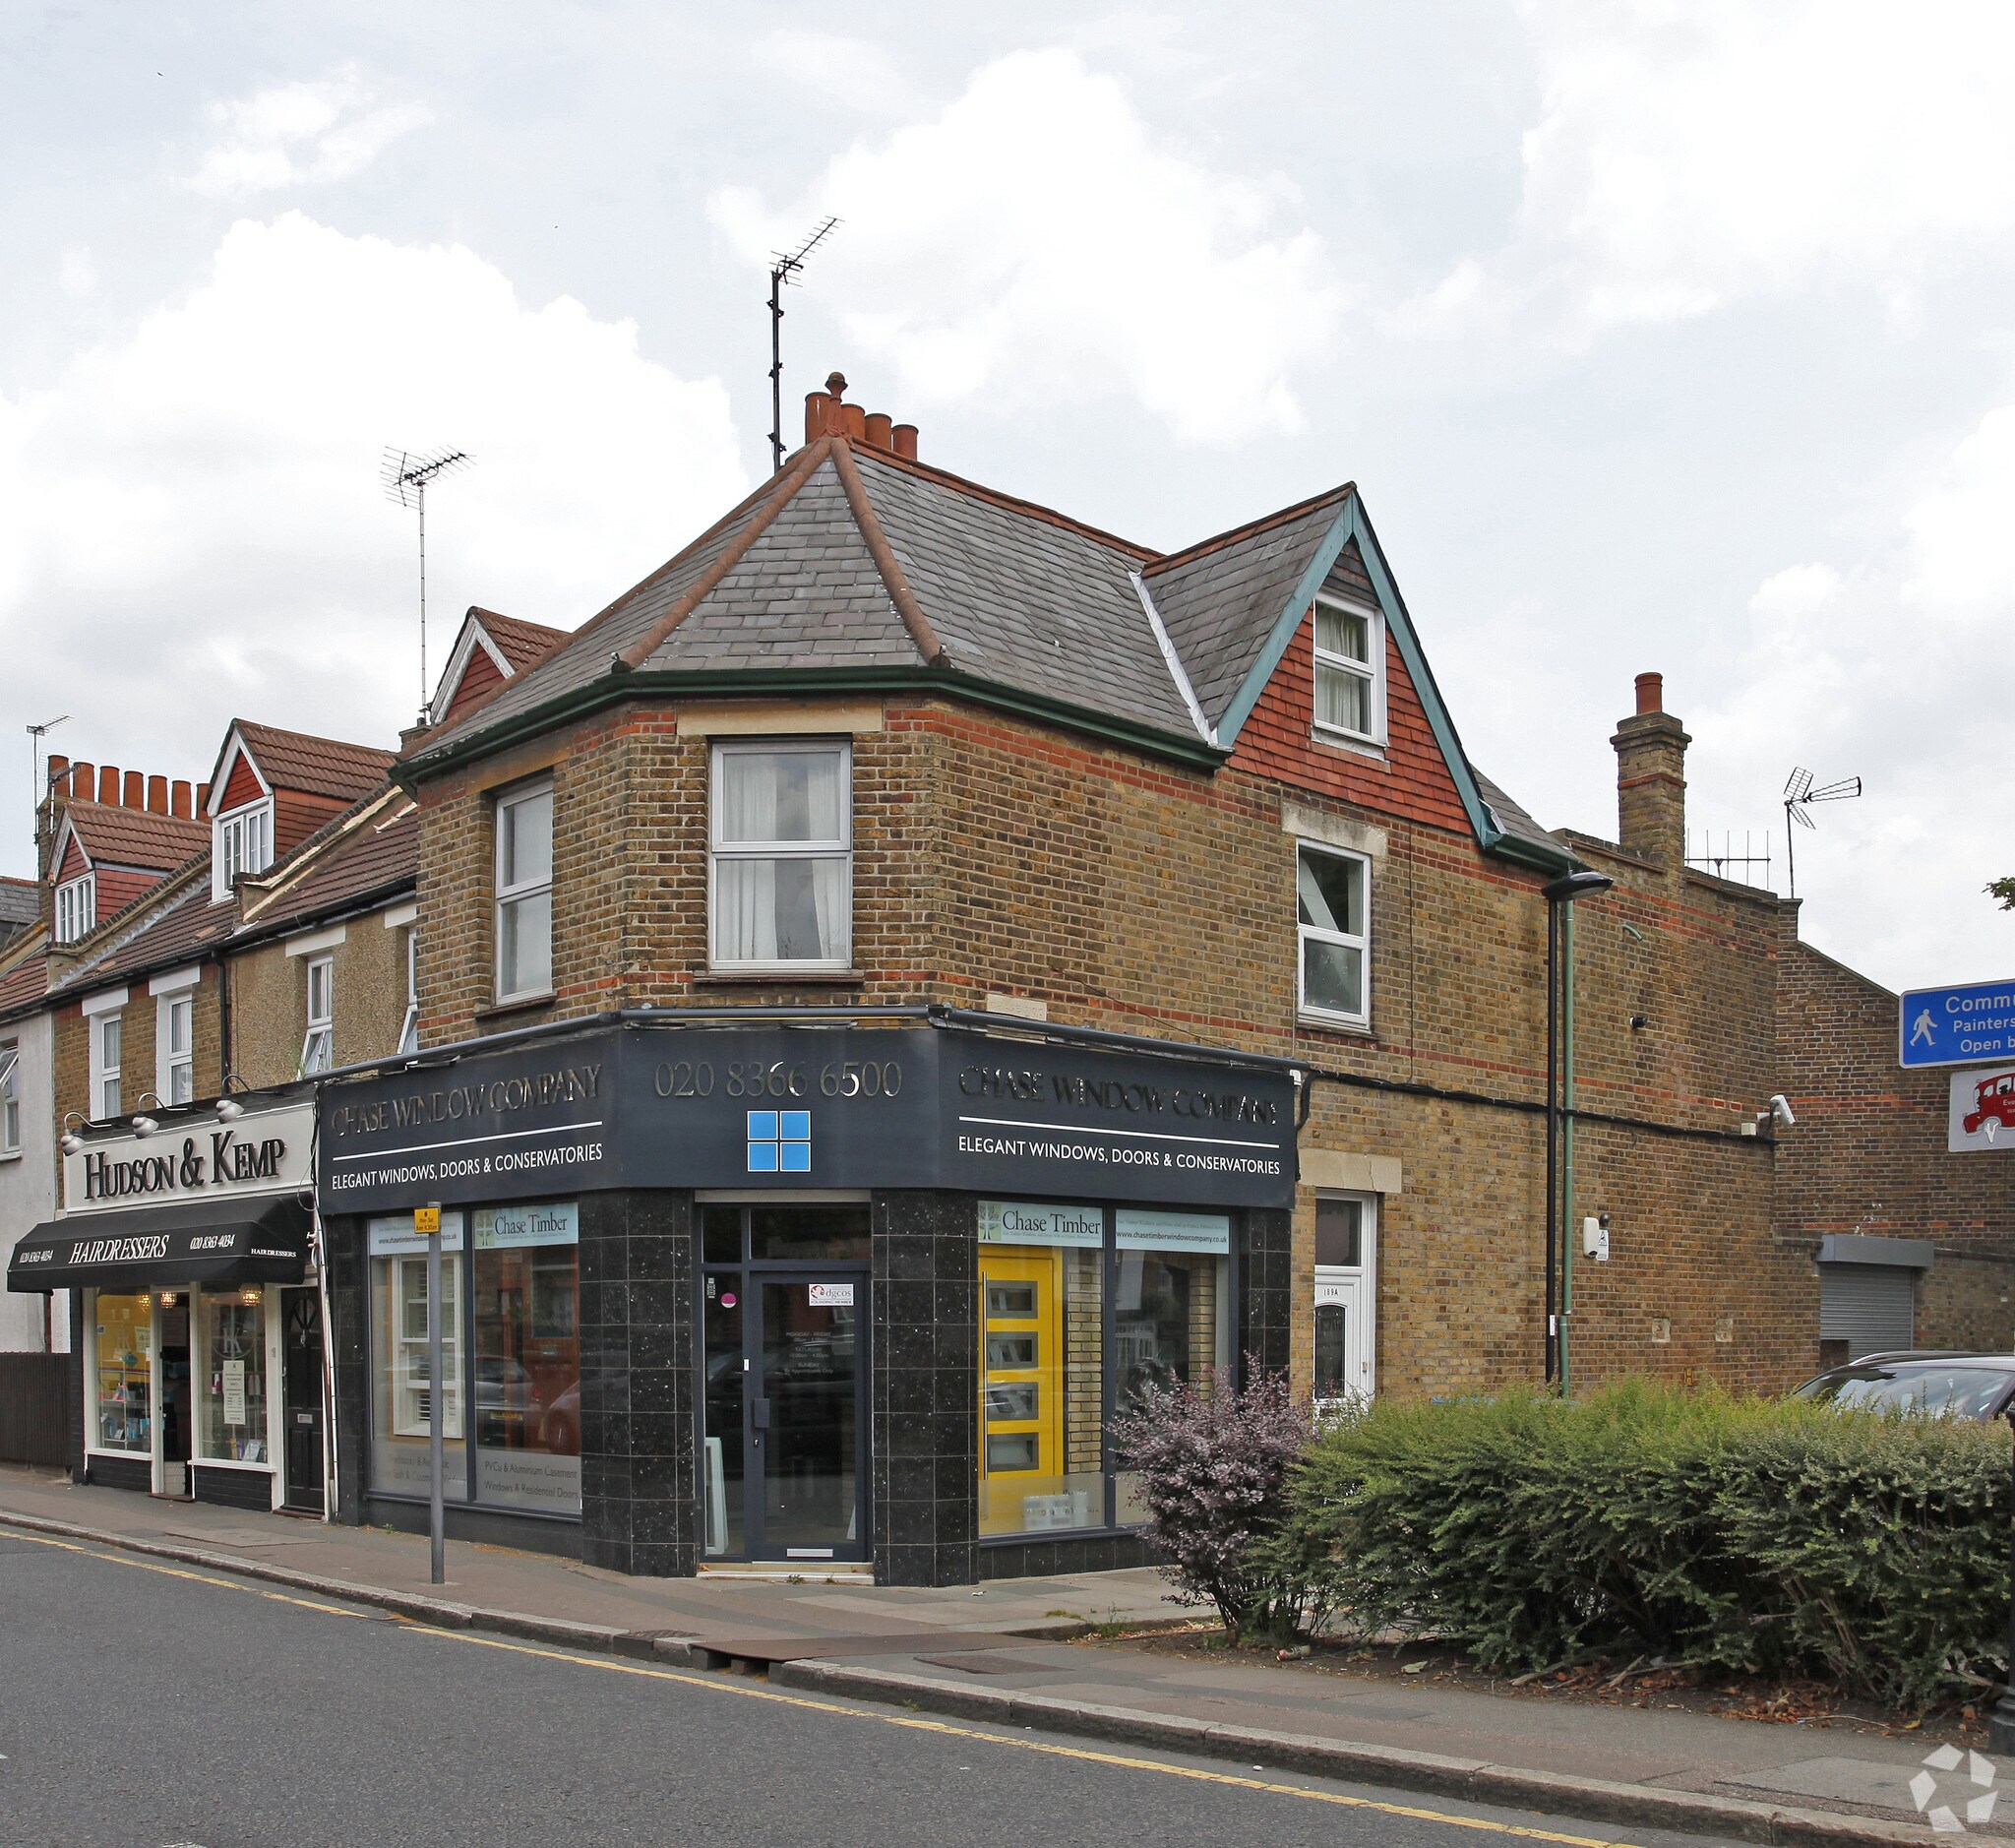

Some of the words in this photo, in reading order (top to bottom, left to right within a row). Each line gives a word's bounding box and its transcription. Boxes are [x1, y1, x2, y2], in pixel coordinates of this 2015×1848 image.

[1945, 995, 2015, 1014] Comm
[1953, 1017, 2015, 1032] Painters
[1960, 1038, 2001, 1053] Open
[654, 1062, 715, 1097] 020
[726, 1061, 808, 1097] 8366
[820, 1061, 902, 1097] 6500
[332, 1101, 389, 1136] CHASE
[393, 1084, 485, 1128] WINDOW
[489, 1064, 601, 1113] COMPANY
[959, 1066, 1045, 1102] CHASE
[1051, 1075, 1167, 1113] WINDOW
[1172, 1090, 1279, 1126] COMPANY
[180, 1138, 205, 1188] &
[332, 1171, 377, 1190] ELEGANT
[379, 1164, 438, 1186] WINDOWS,
[440, 1159, 480, 1179] DOORS
[483, 1158, 491, 1173] &
[495, 1143, 602, 1171] CONSERVATORIES
[958, 1137, 1025, 1155] ELEGANT
[1029, 1141, 1109, 1164] WINDOWS,
[1112, 1148, 1159, 1166] DOORS
[1163, 1152, 1172, 1167] &
[1176, 1154, 1280, 1175] CONSERVATORIES
[495, 1215, 526, 1235] Chase
[527, 1211, 568, 1232] Timber
[1003, 1211, 1047, 1232] Chase
[1050, 1213, 1101, 1235] Timber
[69, 1235, 170, 1264] HAIRDRESSERS
[1116, 1231, 1228, 1244] www.chasetimberwindowcompany.co.uk
[251, 1248, 297, 1258] HAIRDRESSERS
[825, 1285, 852, 1298] dgcos
[504, 1461, 509, 1472] &
[510, 1463, 543, 1476] Aluminium
[544, 1465, 578, 1478] Casement
[484, 1480, 514, 1493] Windows
[515, 1482, 519, 1492] &
[521, 1483, 556, 1497] Residential
[557, 1485, 579, 1500] Doors
